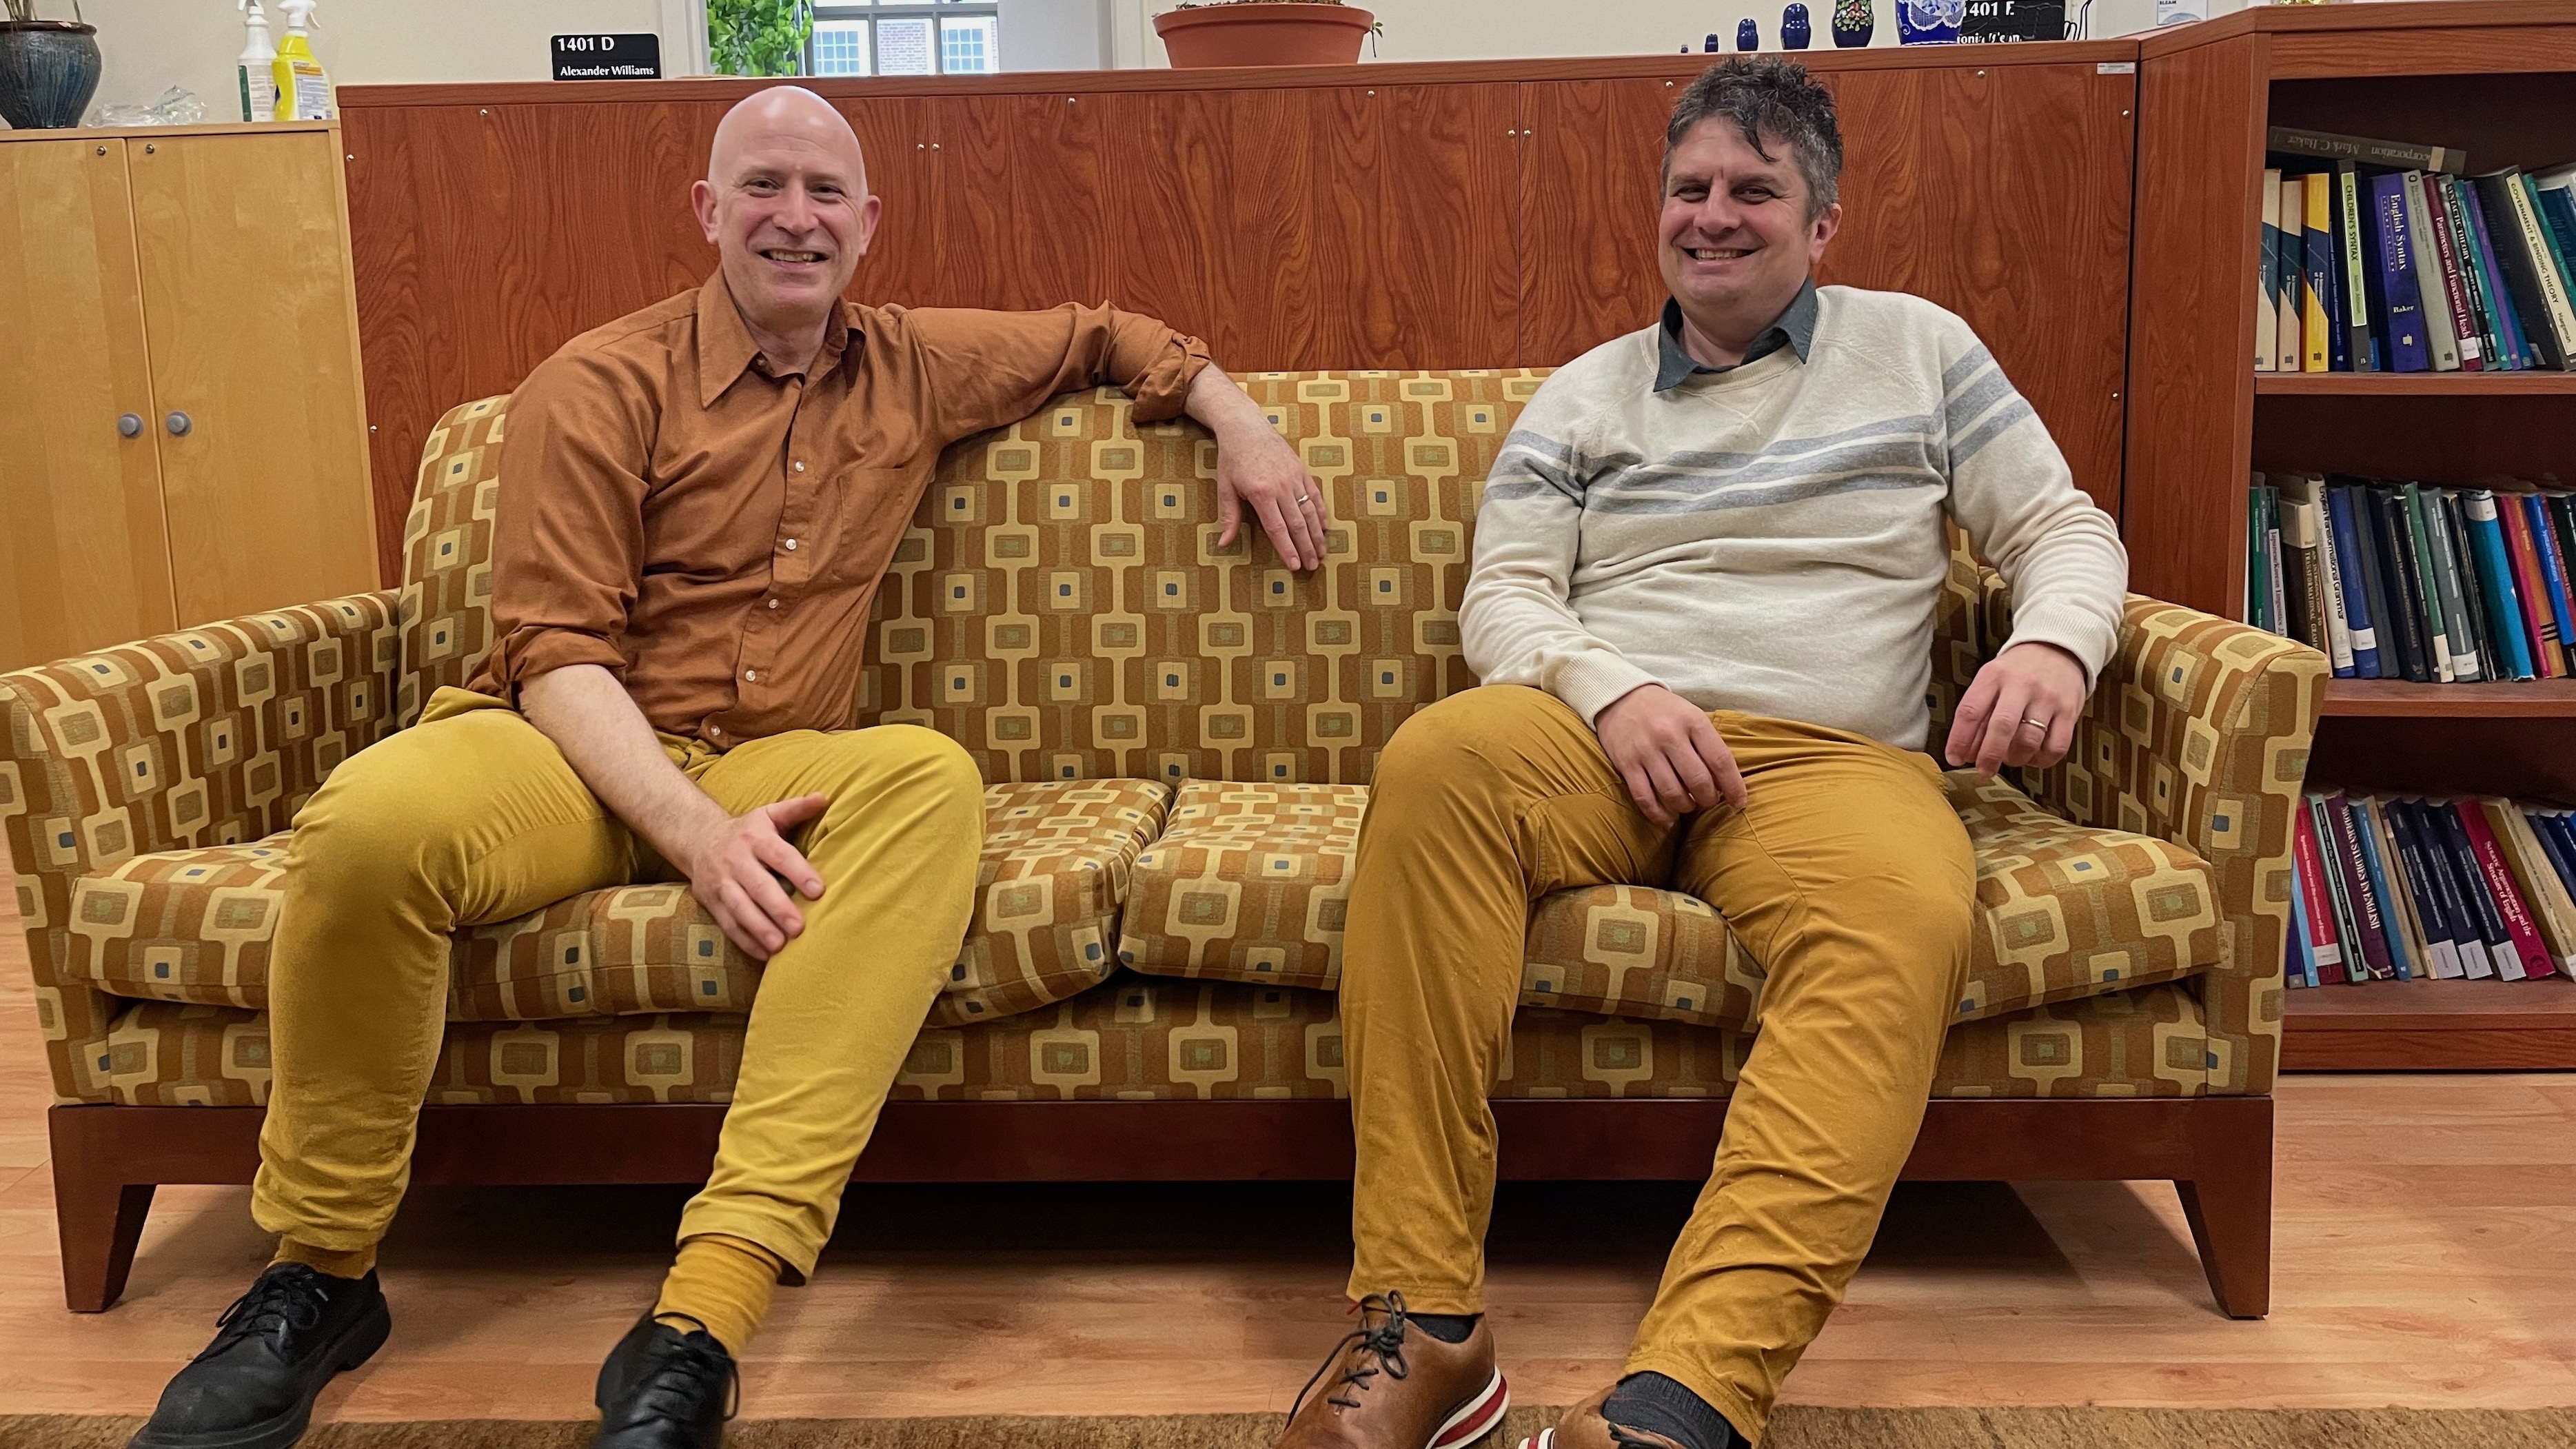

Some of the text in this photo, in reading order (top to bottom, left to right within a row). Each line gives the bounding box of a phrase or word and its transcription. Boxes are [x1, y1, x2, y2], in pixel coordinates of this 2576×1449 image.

[558, 37, 615, 52] 1401 D
[560, 65, 654, 76] Alexander Williams
[2331, 141, 2360, 155] Mark
[2371, 146, 2431, 161] corporation
[2346, 185, 2358, 261] CHILDREN'S SYNTAX
[2391, 194, 2406, 270] English Syntax
[2447, 184, 2464, 230] SYNTACTIC
[2457, 230, 2470, 260] THEORY
[2511, 183, 2533, 234] GOVERNMENT
[2532, 242, 2548, 276] BINDING
[2544, 275, 2559, 303] THEORY
[2435, 216, 2471, 338] Parameters and Functional Heads
[2558, 312, 2571, 343] Haegeman
[2270, 531, 2280, 587] Japanese/Korean
[2319, 485, 2344, 619] English Transformational Grammar
[2341, 805, 2357, 843] MODERN
[2351, 842, 2368, 881] STUDIES
[2360, 880, 2370, 892] IN
[2362, 892, 2380, 929] ENGLISH
[2517, 913, 2529, 929] and
[2523, 926, 2532, 937] the
